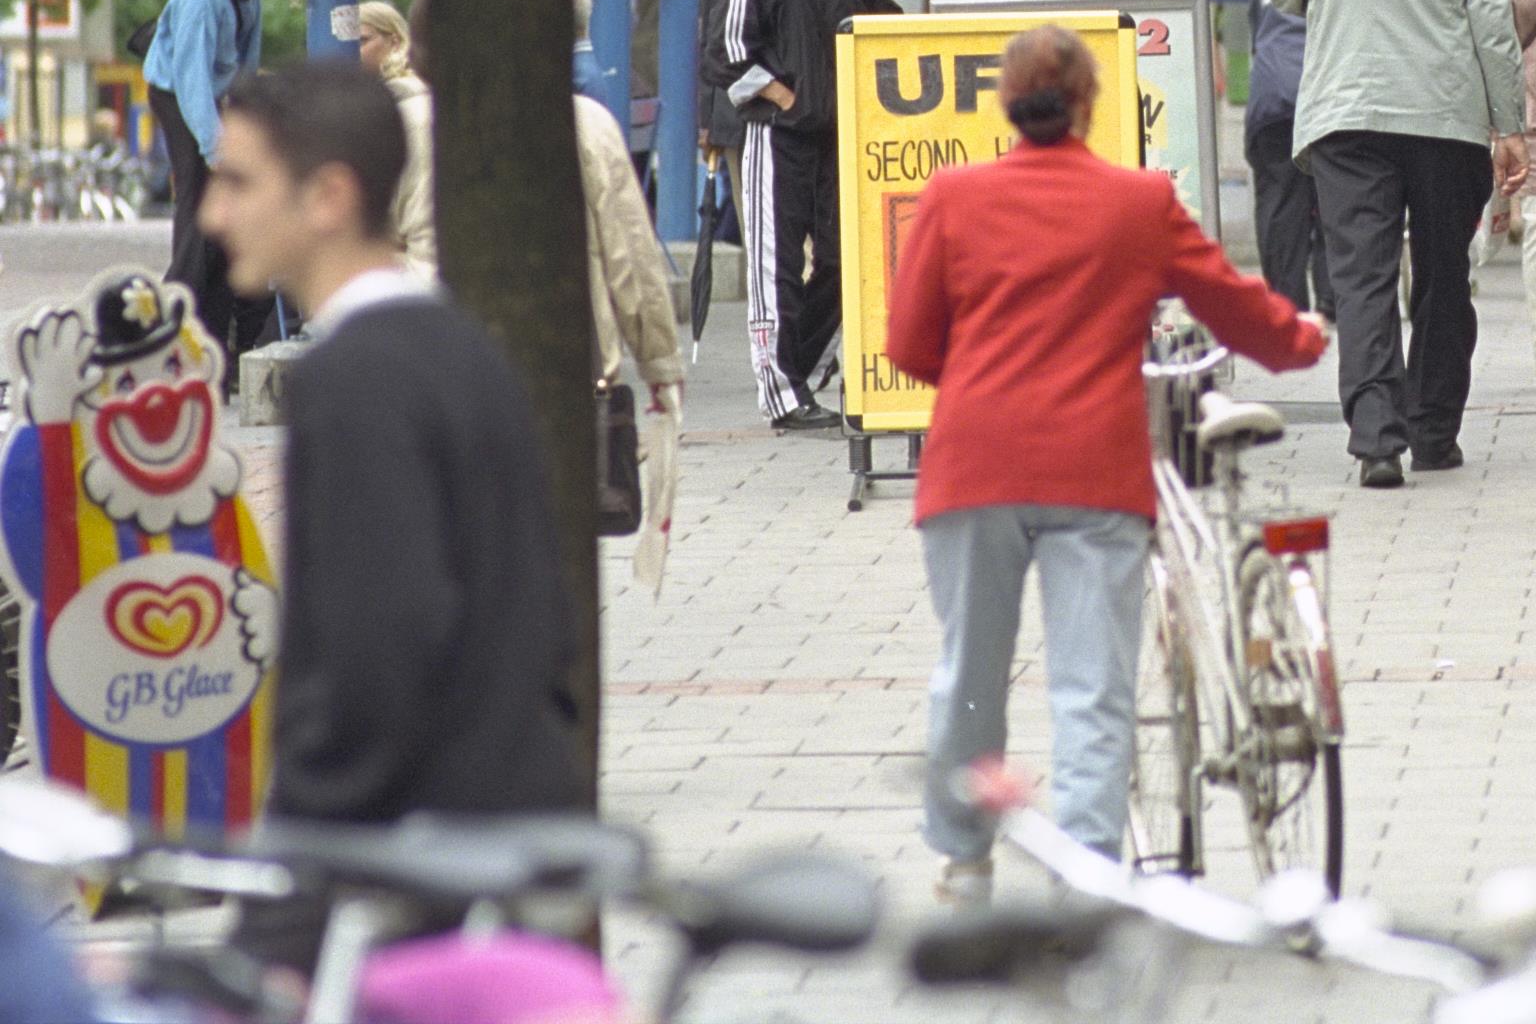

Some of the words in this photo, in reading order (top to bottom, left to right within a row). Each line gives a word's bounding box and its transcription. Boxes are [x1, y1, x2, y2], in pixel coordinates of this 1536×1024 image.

[875, 54, 1003, 116] UF
[866, 138, 968, 182] SECOND
[105, 671, 157, 724] GB
[162, 664, 234, 718] Glace
